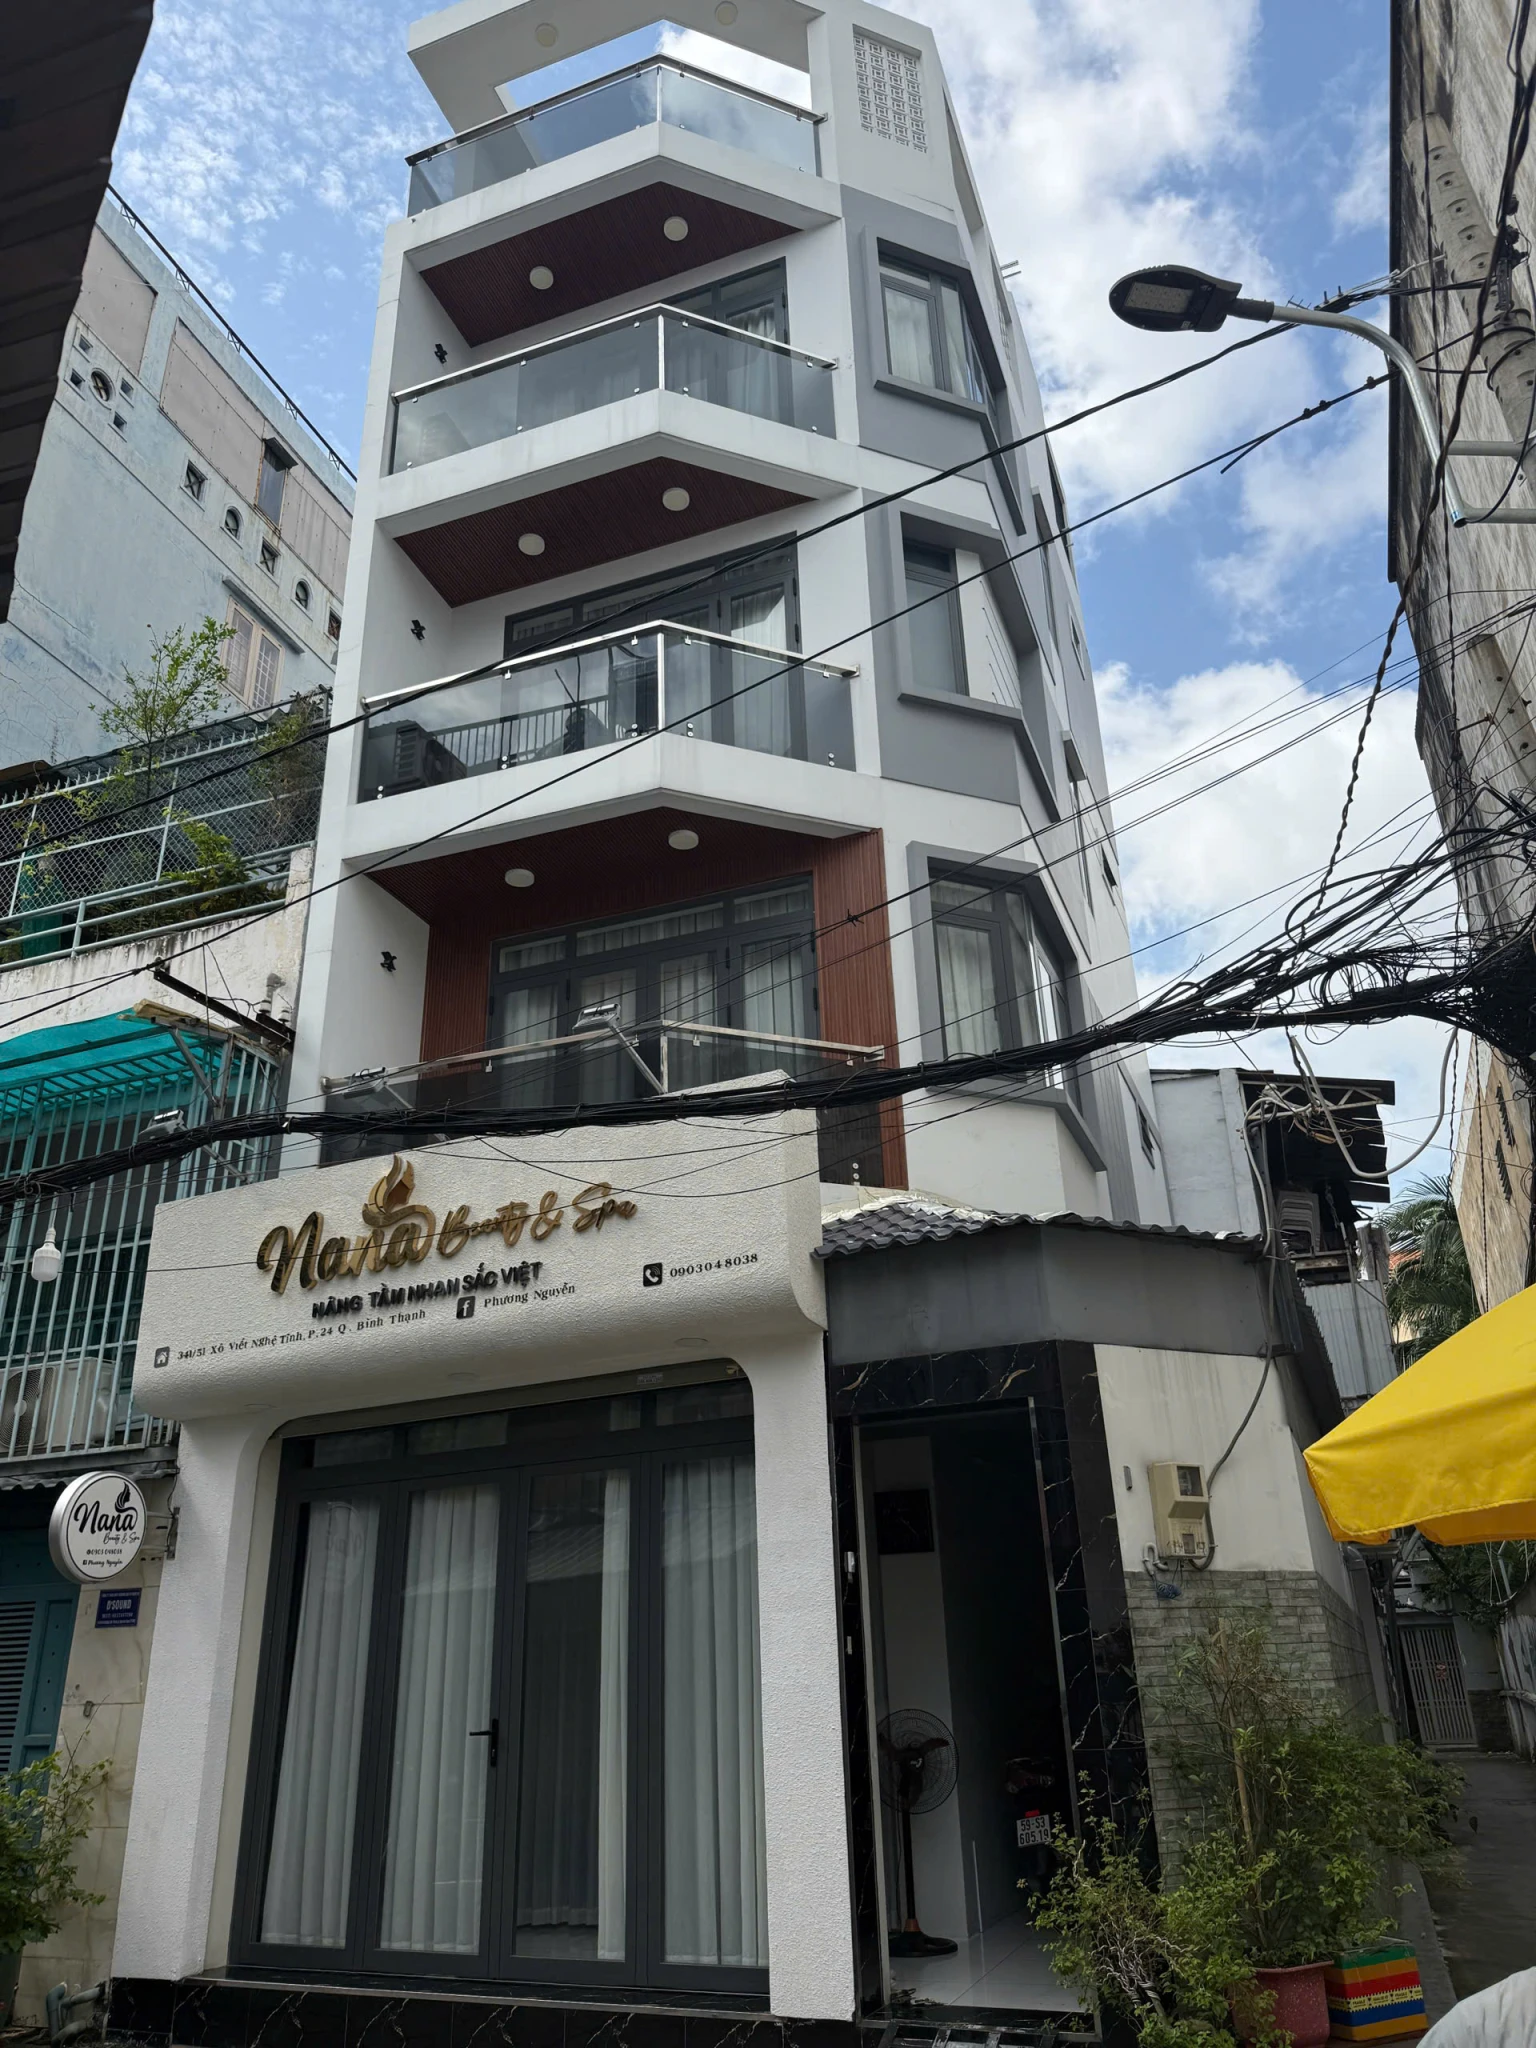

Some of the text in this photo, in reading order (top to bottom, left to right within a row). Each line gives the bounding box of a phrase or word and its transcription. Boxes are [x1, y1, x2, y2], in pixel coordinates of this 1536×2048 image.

[437, 1182, 638, 1258] Beauty & Spa
[257, 1204, 437, 1295] Nana
[312, 1295, 364, 1319] NÂNG
[407, 1278, 460, 1302] NHAN
[462, 1262, 498, 1292] SẮC
[501, 1260, 543, 1288] VIỆT
[484, 1282, 575, 1308] Phương Nguyễn
[210, 1343, 225, 1355] Xô
[228, 1338, 248, 1351] Viết
[251, 1335, 278, 1349] Nghệ
[356, 1317, 384, 1331] Bình
[389, 1309, 426, 1324] Thạnh
[73, 1500, 138, 1534] Nana
[1019, 1828, 1050, 1845] 605.19
[1020, 1816, 1046, 1832] 59-S3
